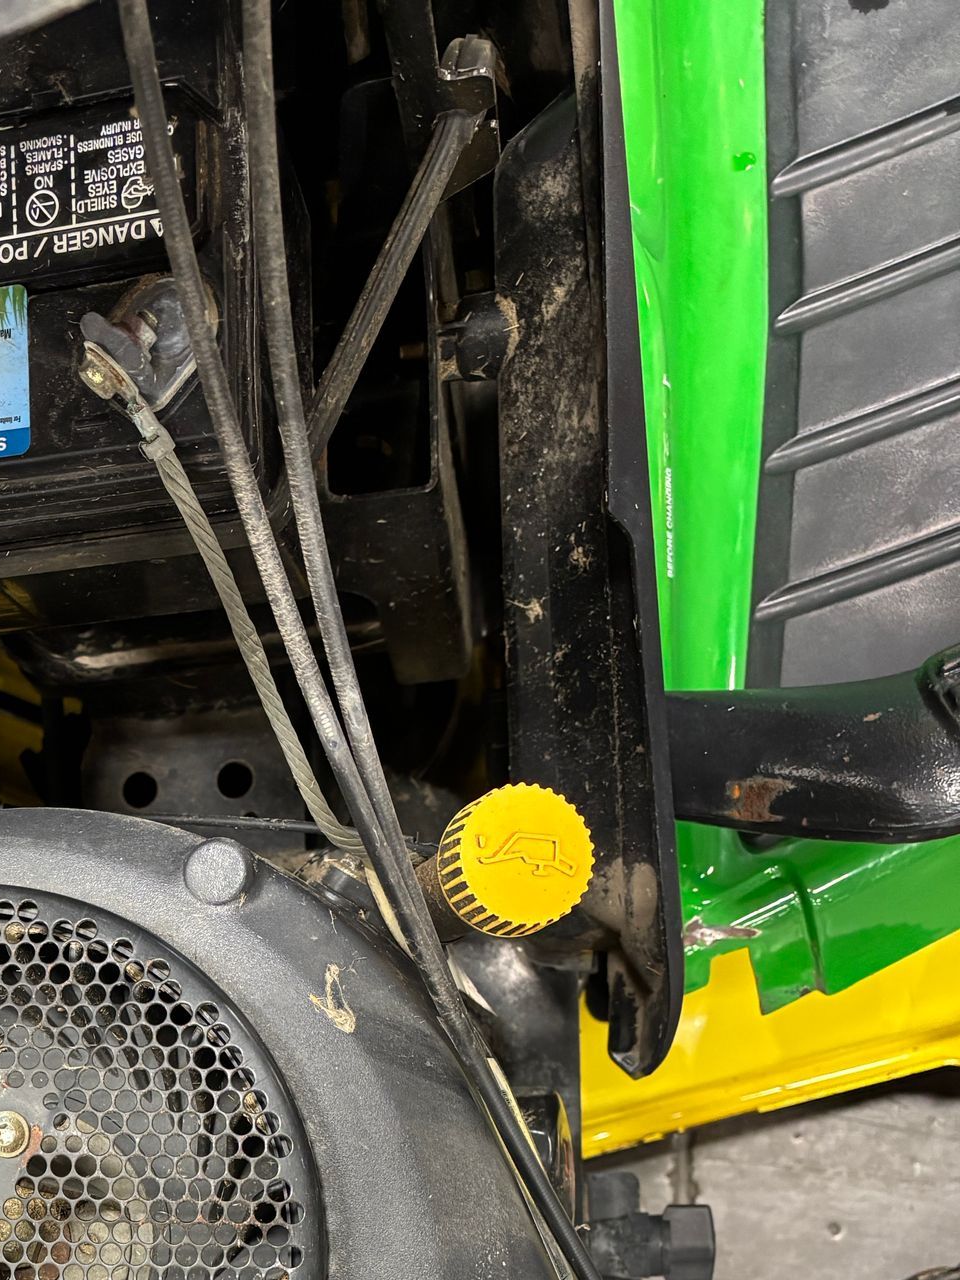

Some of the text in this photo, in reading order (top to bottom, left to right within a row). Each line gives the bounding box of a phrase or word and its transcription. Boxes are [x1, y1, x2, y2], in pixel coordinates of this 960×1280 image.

[100, 121, 131, 136] INJURY
[20, 135, 62, 152] SMOKING
[77, 134, 123, 153] BLINDNESS
[107, 145, 144, 163] GASES
[84, 161, 144, 183] EXPLOSIVE
[34, 175, 53, 190] NO
[88, 180, 116, 197] EYES
[77, 195, 117, 213] SHIELD
[53, 219, 146, 253] DANGER
